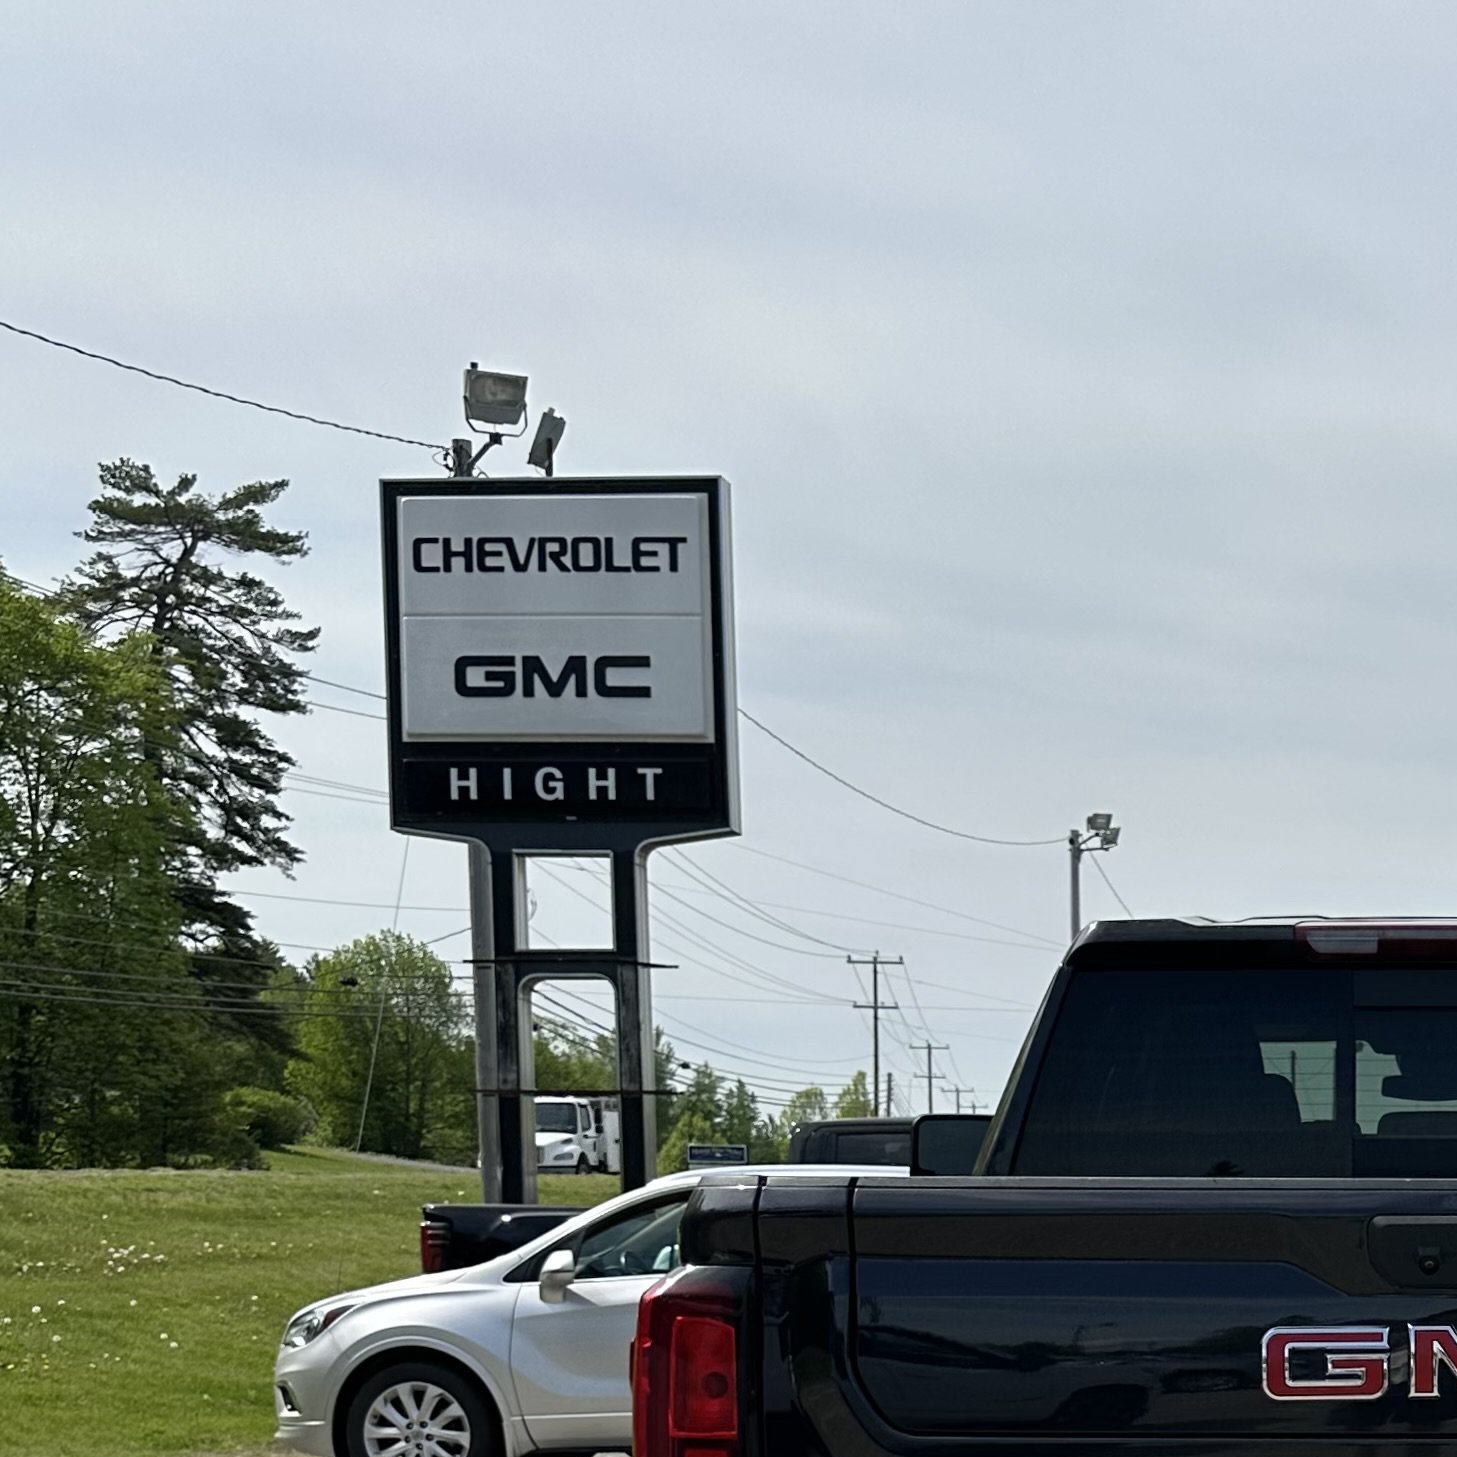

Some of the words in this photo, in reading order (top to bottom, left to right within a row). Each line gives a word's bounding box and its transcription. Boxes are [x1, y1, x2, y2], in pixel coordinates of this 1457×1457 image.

[413, 536, 688, 574] CHEVROLET
[454, 655, 652, 698] GMC
[449, 766, 663, 802] HIGHT
